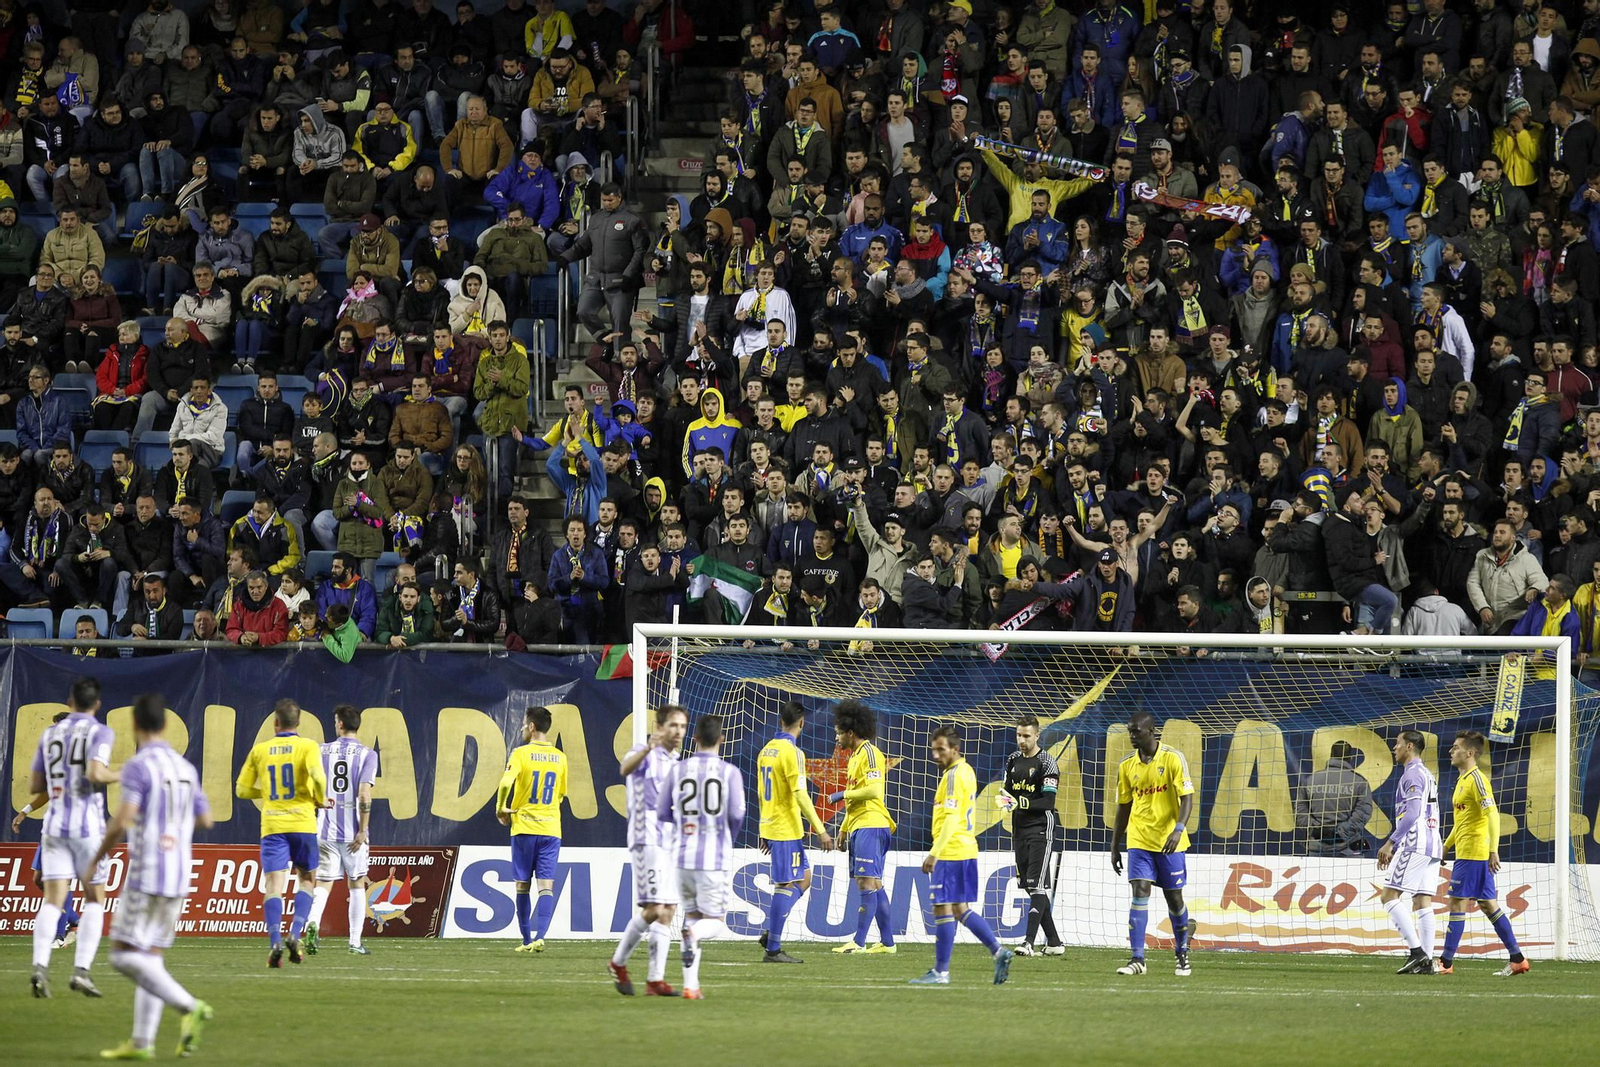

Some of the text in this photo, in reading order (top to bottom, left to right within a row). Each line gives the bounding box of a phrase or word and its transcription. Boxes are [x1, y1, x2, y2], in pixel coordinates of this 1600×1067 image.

[803, 569, 840, 578] CAFFEINE
[48, 738, 87, 779] 24
[267, 763, 296, 801] 19
[332, 761, 349, 794] 8
[529, 771, 557, 805] 18
[1306, 784, 1354, 794] SECURITAS
[680, 778, 722, 816] 20
[387, 857, 407, 866] TODO
[408, 857, 418, 866] EL
[418, 855, 434, 866] AÑO
[206, 898, 250, 915] CONIL
[453, 859, 1036, 938] SASUNG
